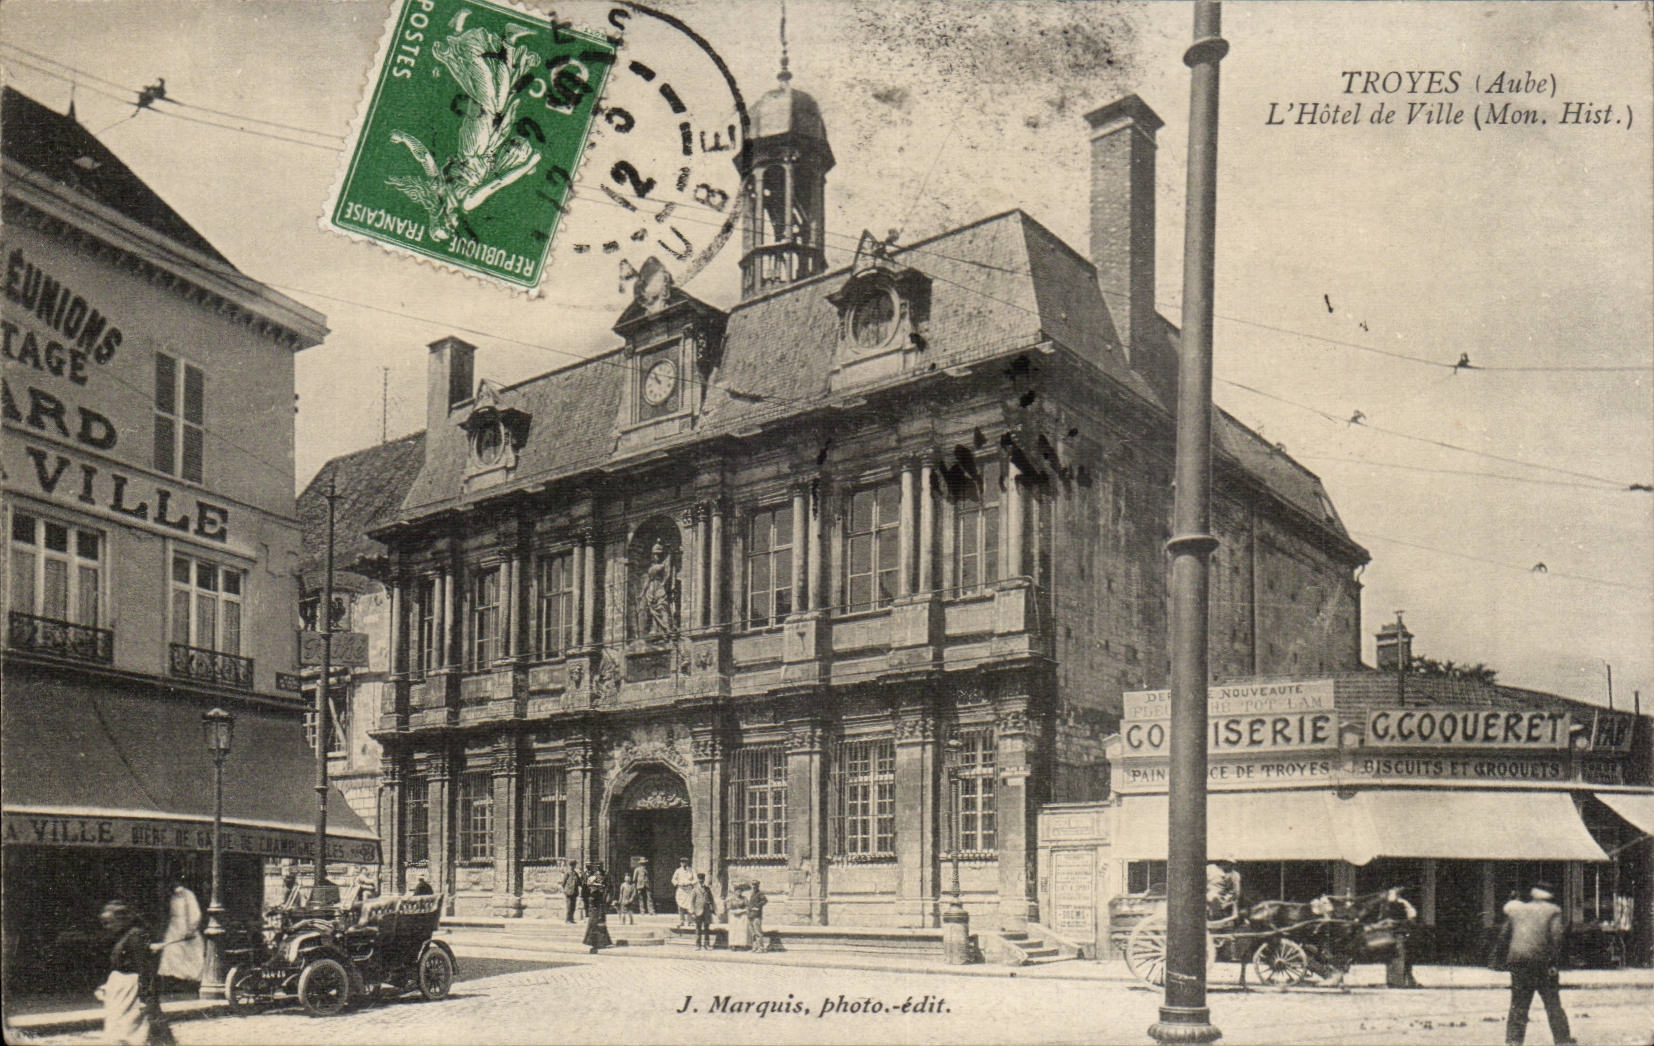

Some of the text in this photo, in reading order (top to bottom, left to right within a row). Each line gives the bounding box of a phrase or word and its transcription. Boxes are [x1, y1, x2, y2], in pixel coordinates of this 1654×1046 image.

[391, 0, 434, 79] POSTES
[344, 201, 425, 242] FRANÇAISE
[26, 446, 228, 544] VILLE
[1126, 715, 1331, 749] COISERIE
[1131, 768, 1166, 783] PAIN
[1236, 765, 1254, 780] DE
[1262, 761, 1330, 777] TROYES
[1363, 760, 1443, 776] BISCUITS
[1451, 761, 1469, 775] ET
[30, 819, 115, 844] VILLE
